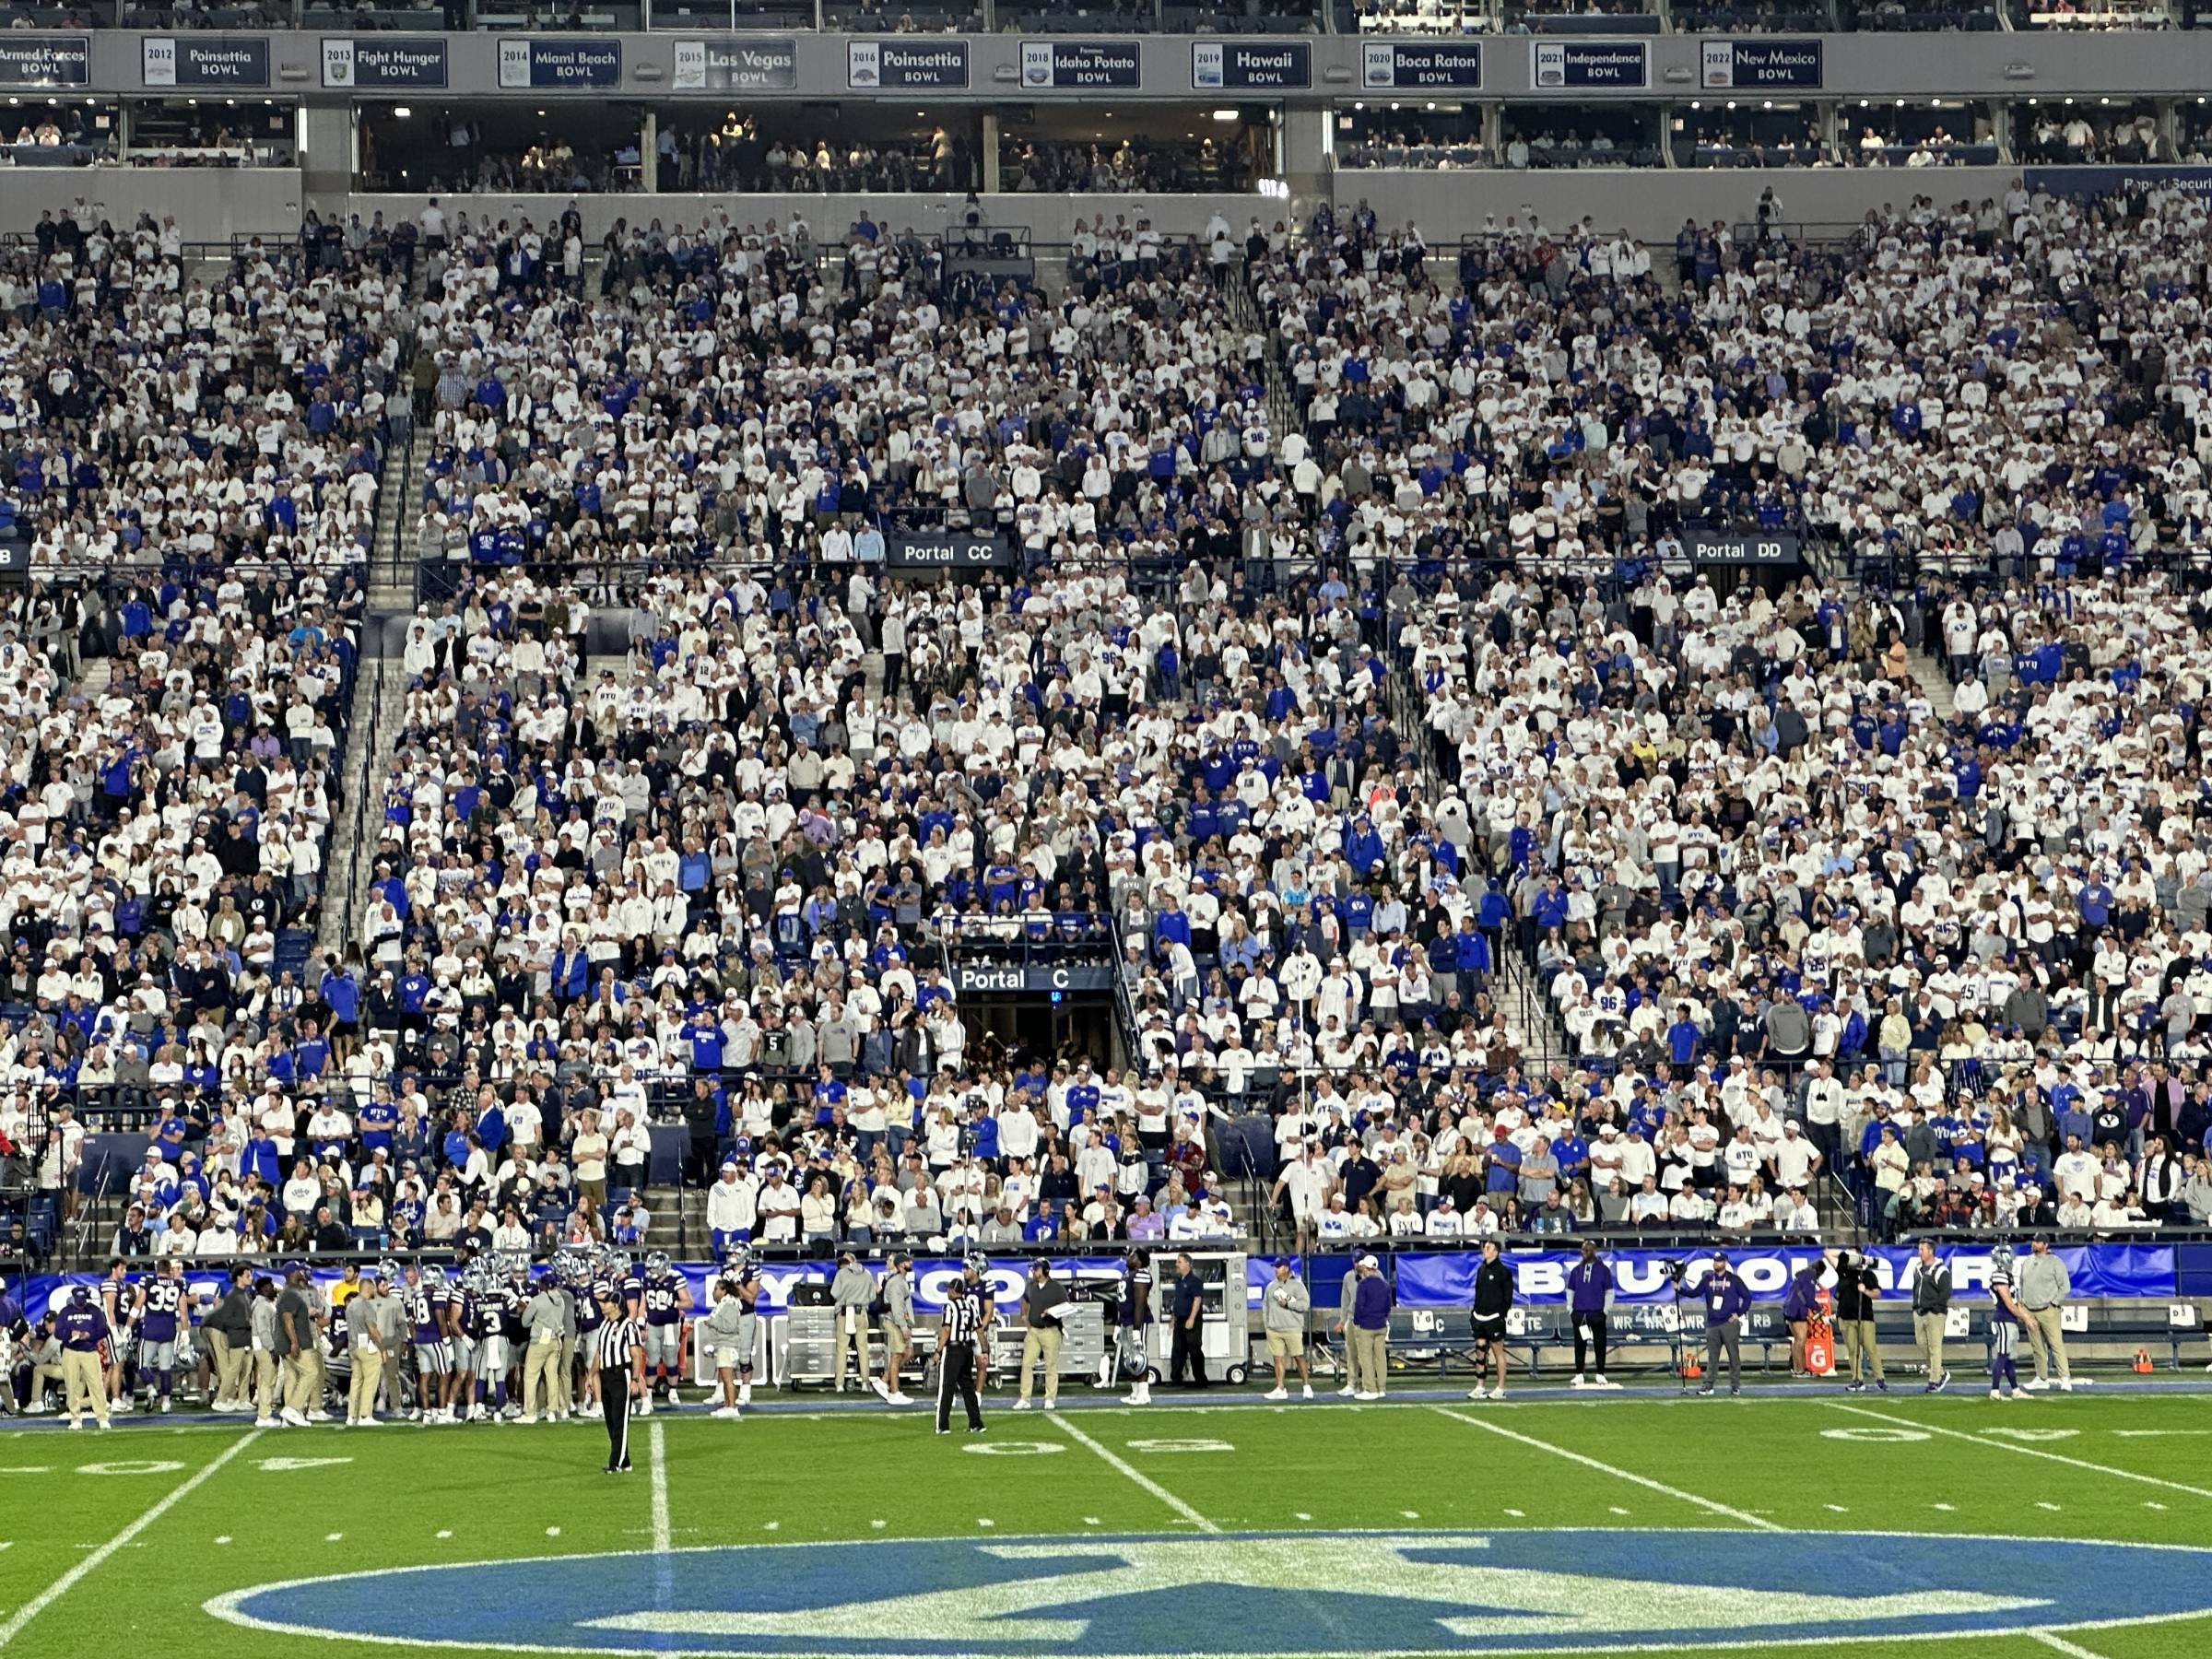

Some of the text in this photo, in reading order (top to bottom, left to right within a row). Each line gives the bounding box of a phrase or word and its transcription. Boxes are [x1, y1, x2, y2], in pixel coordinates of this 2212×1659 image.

[0, 49, 85, 61] Armed Forces
[148, 49, 171, 59] 2012
[190, 49, 251, 62] Poinsettia
[327, 51, 351, 60] 2013
[358, 51, 441, 65] Fight Hunger
[504, 51, 527, 61] 2014
[535, 52, 616, 64] Miami Beach
[679, 52, 701, 62] 2015
[853, 53, 876, 62] 2016
[883, 52, 962, 66] Poinsettia
[1027, 53, 1049, 63] 2018
[1197, 53, 1219, 64] 2019
[1237, 52, 1292, 68] Hawaii
[1368, 53, 1390, 64] 2020
[1540, 53, 1562, 63] 2021
[1567, 53, 1641, 65] Independence
[1706, 53, 1730, 64] 2022
[1736, 50, 1816, 65] New Mexico
[710, 51, 792, 70] Las Vegas
[1055, 56, 1135, 68] Idaho Potato
[1396, 54, 1476, 67] Boca Raton
[22, 63, 59, 74] BOWL
[202, 64, 239, 76] BOWL
[381, 65, 418, 76] BOWL
[557, 66, 594, 76] BOWL
[1587, 67, 1620, 77] BOWL
[1759, 69, 1794, 79] BOWL
[732, 72, 768, 82] BOWL
[905, 71, 940, 82] BOWL
[1077, 73, 1112, 83] BOWL
[1248, 72, 1283, 83] BOWL
[1418, 73, 1453, 82] BOWL
[1251, 432, 1264, 443] 96
[905, 546, 993, 560] Portal CC
[1697, 543, 1782, 558] Portal DD
[1102, 652, 1116, 665] 96
[961, 969, 1070, 989] Portal C
[1599, 996, 1617, 1010] 96
[769, 1036, 777, 1051] 5
[1517, 1260, 1665, 1294] BU
[147, 1284, 180, 1312] 39
[483, 1312, 501, 1333] 3
[1526, 1316, 1543, 1331] TE
[1613, 1315, 1633, 1329] WR
[1685, 1314, 1705, 1329] WR
[1753, 1314, 1771, 1327] RB
[1810, 1349, 1826, 1368] G
